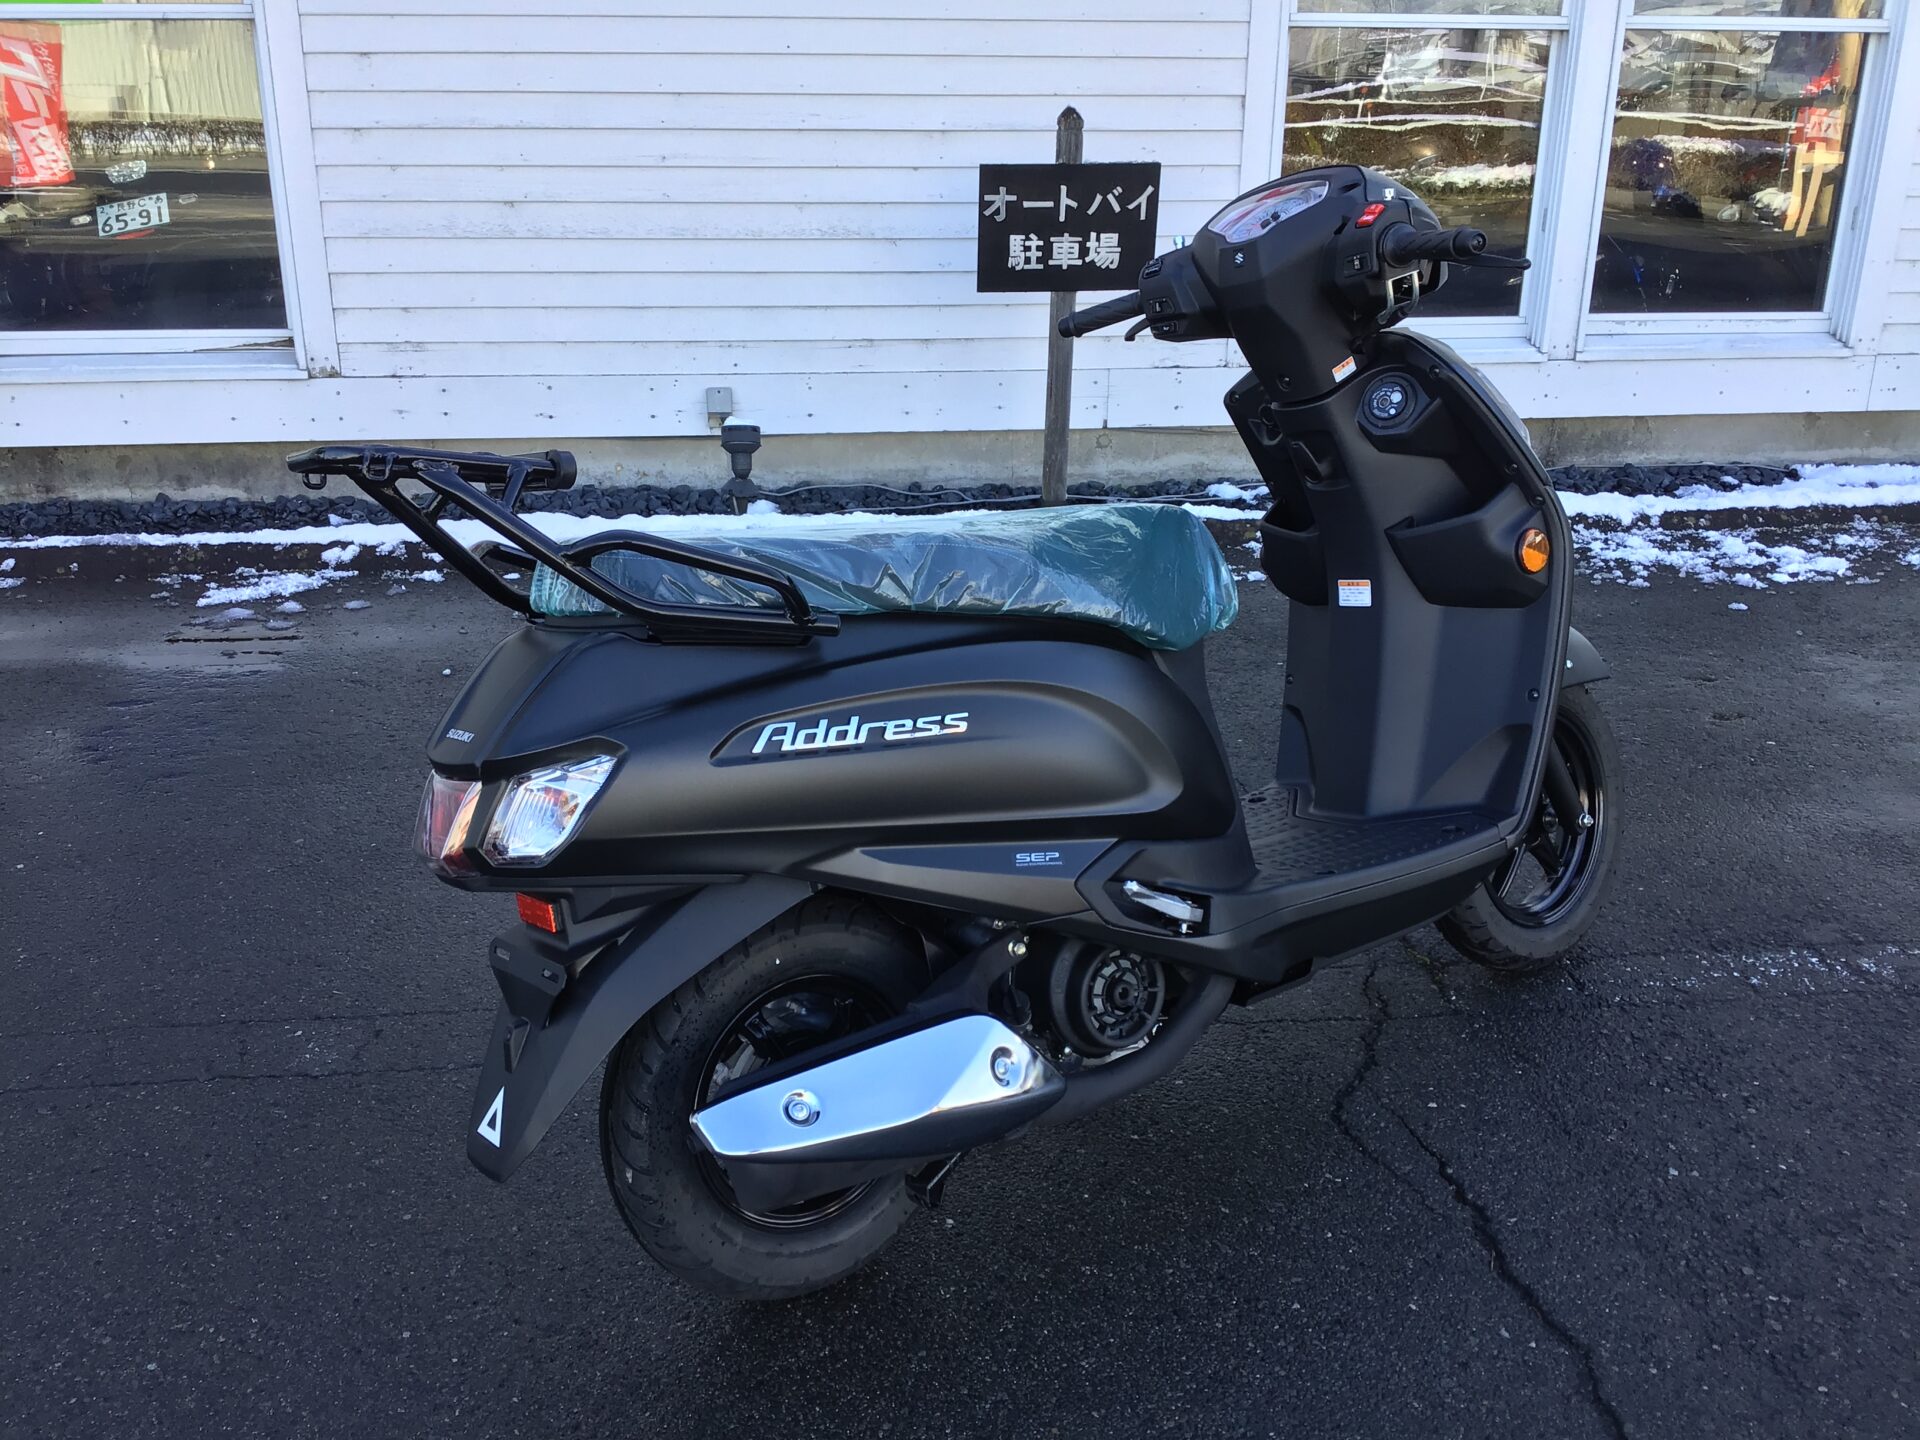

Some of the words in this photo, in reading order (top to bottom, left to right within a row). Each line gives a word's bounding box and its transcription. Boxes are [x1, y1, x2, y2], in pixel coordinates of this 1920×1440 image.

[101, 206, 163, 233] 65-91
[983, 185, 1155, 222] オートバイ
[1008, 232, 1121, 271] 駐車場
[446, 729, 475, 743] SUZUKI
[752, 712, 969, 754] Address
[1015, 852, 1060, 862] SEP
